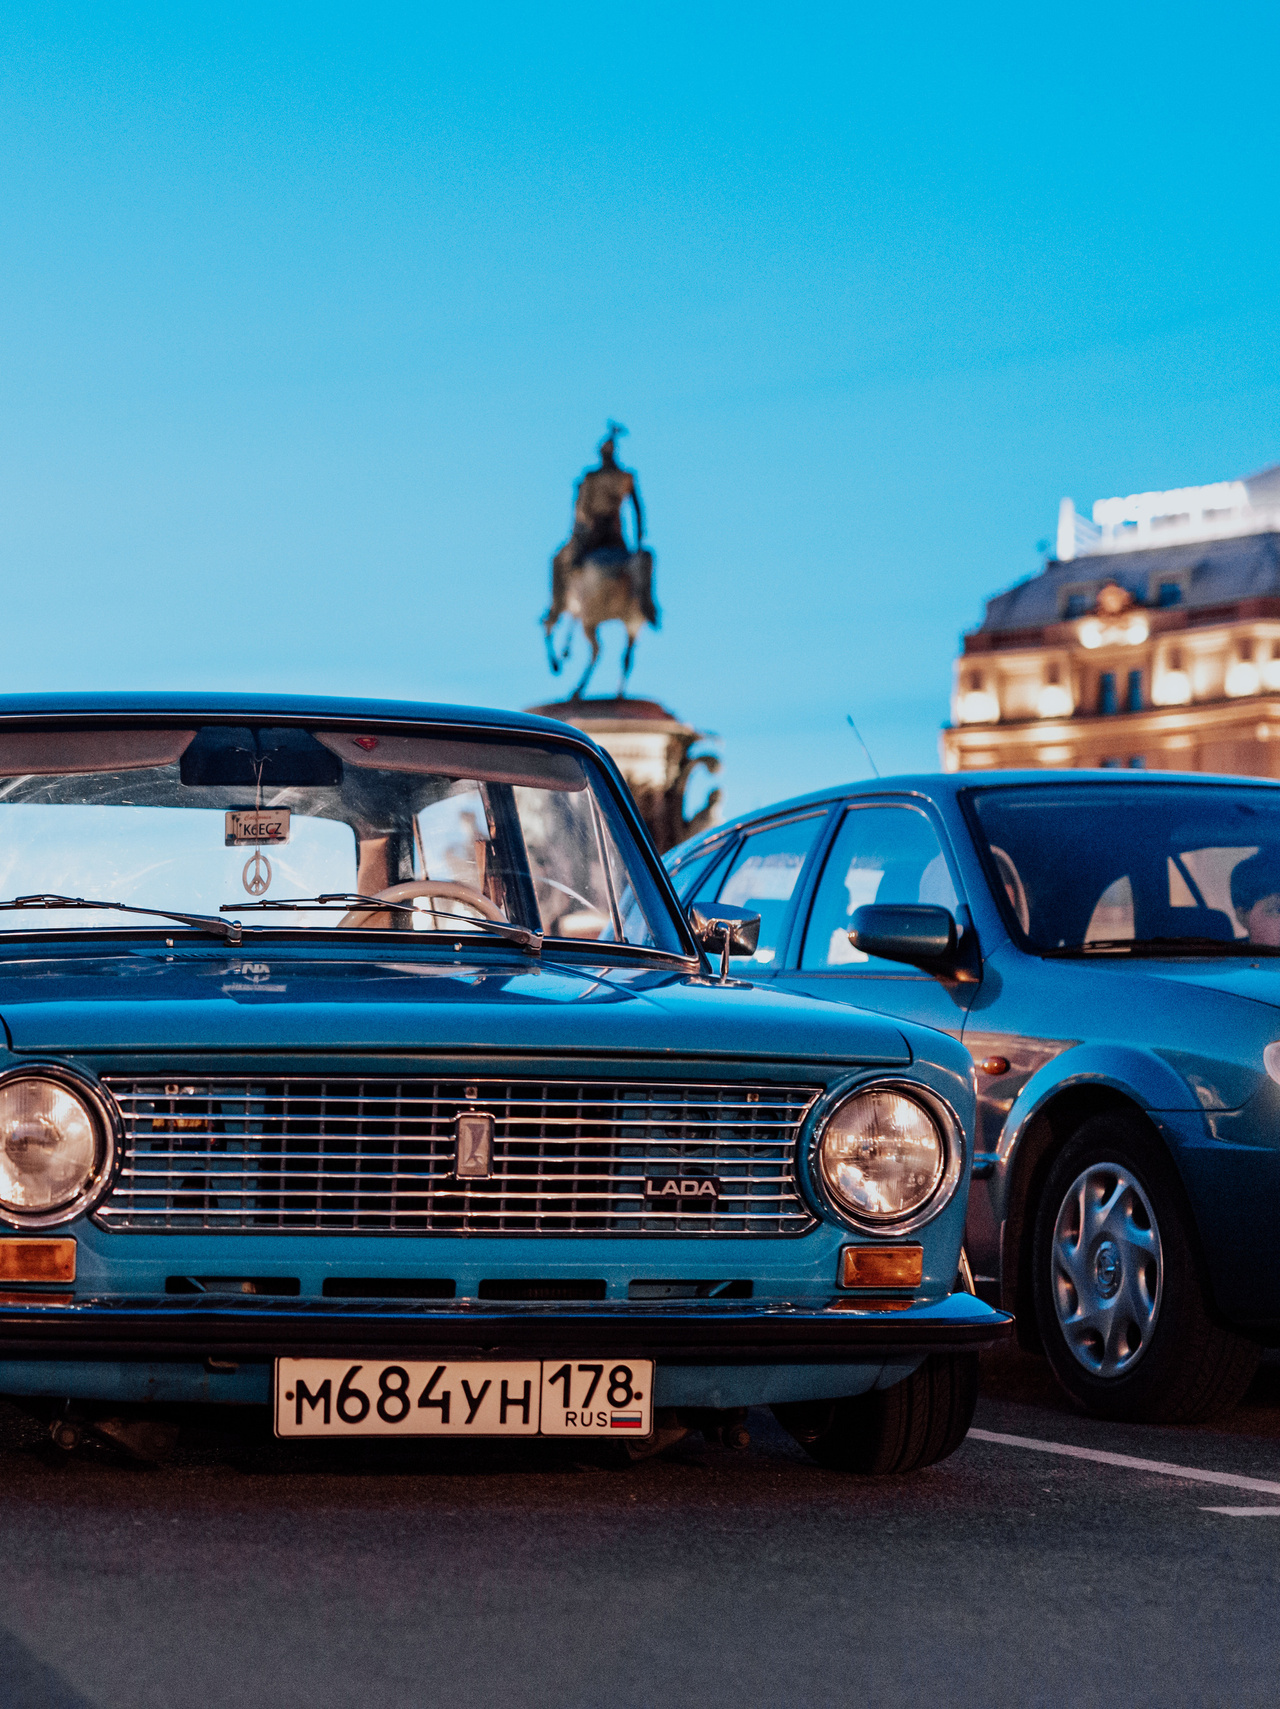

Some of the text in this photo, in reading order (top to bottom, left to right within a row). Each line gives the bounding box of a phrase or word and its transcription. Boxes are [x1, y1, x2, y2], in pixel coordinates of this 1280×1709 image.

[646, 1180, 717, 1196] LADA
[548, 1364, 634, 1409] 178
[565, 1411, 608, 1428] RUS
